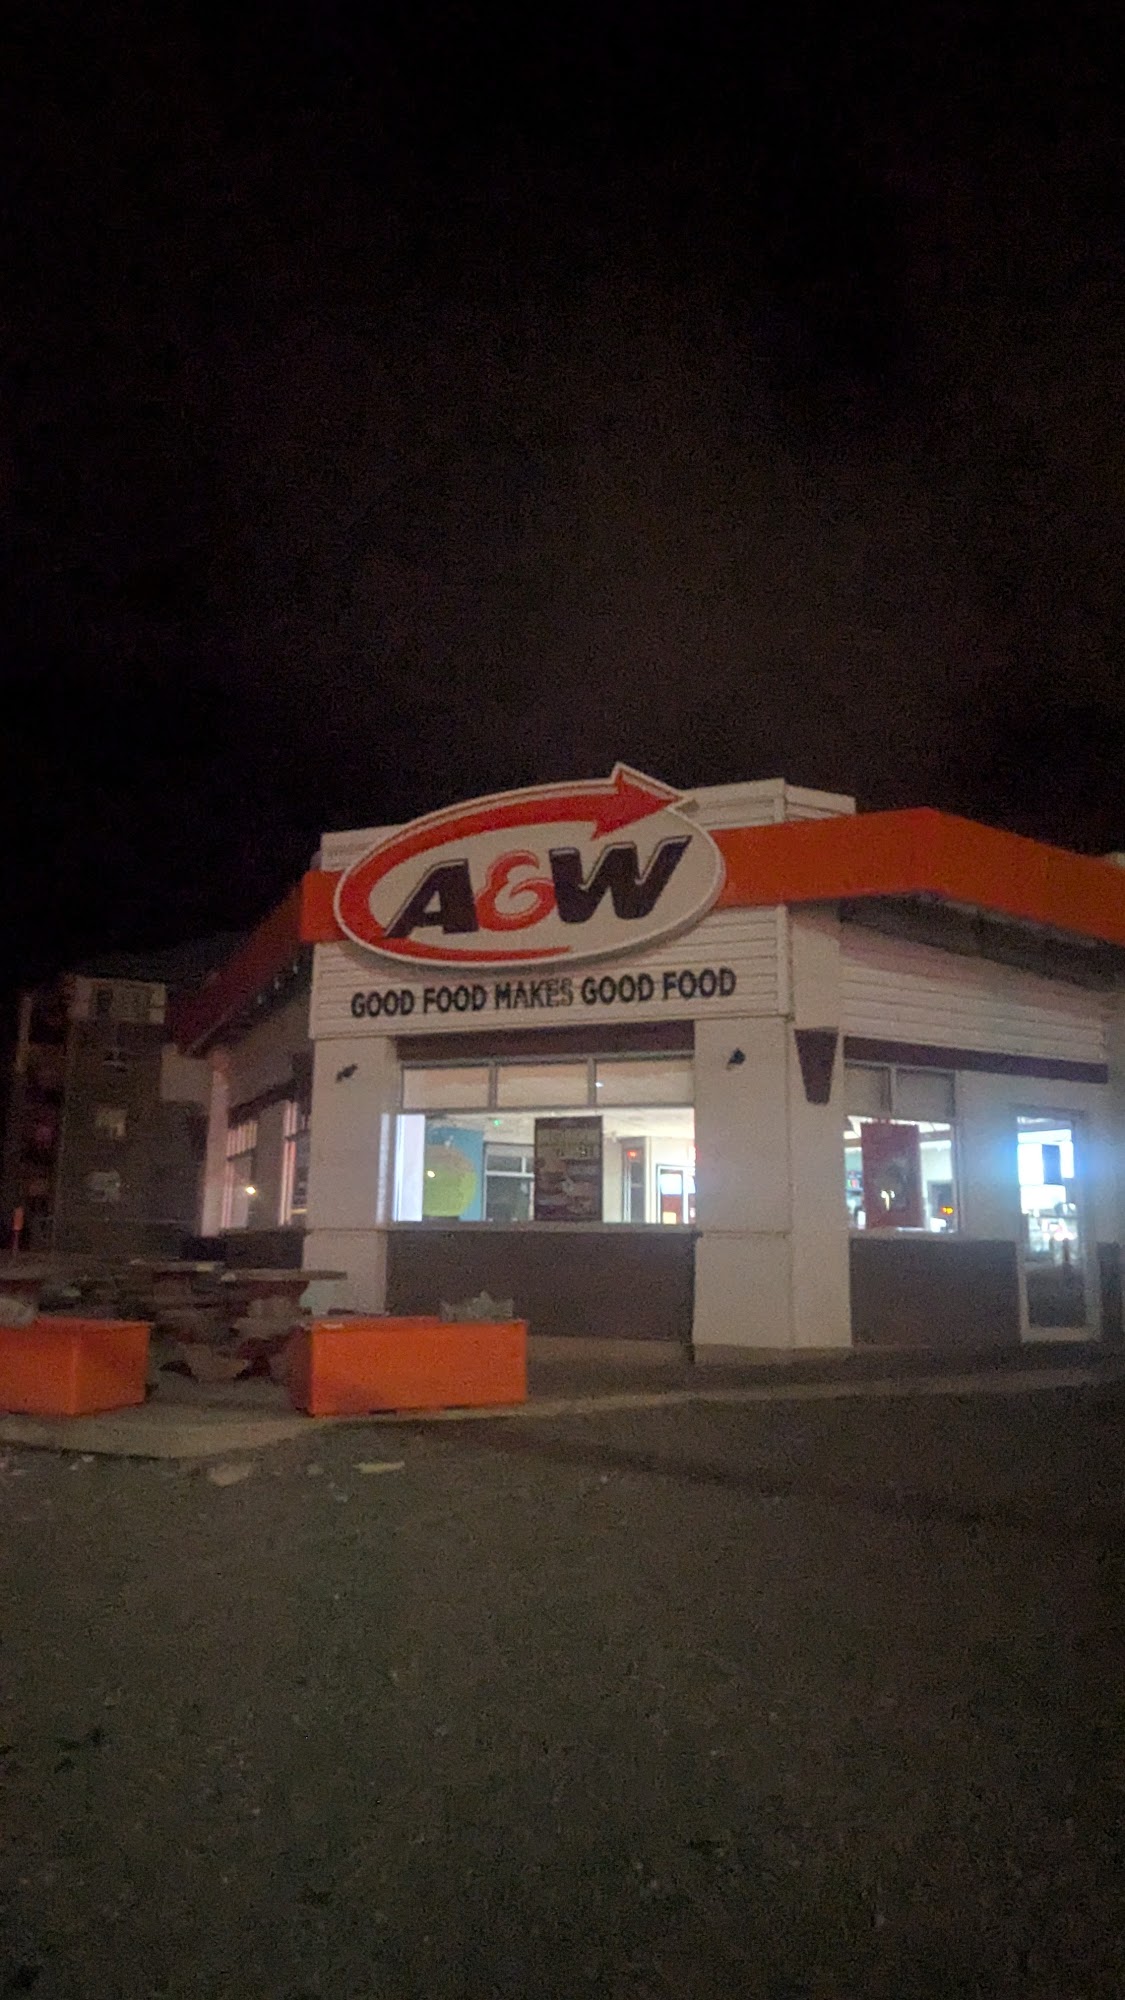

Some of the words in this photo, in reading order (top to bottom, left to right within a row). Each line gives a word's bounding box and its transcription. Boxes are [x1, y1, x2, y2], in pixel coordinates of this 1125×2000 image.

[383, 834, 693, 938] A&W
[351, 989, 415, 1018] GOOD
[423, 984, 487, 1014] FOOD
[495, 977, 574, 1009] MAKES
[580, 975, 654, 1005] GOOD
[663, 966, 737, 999] FOOD
